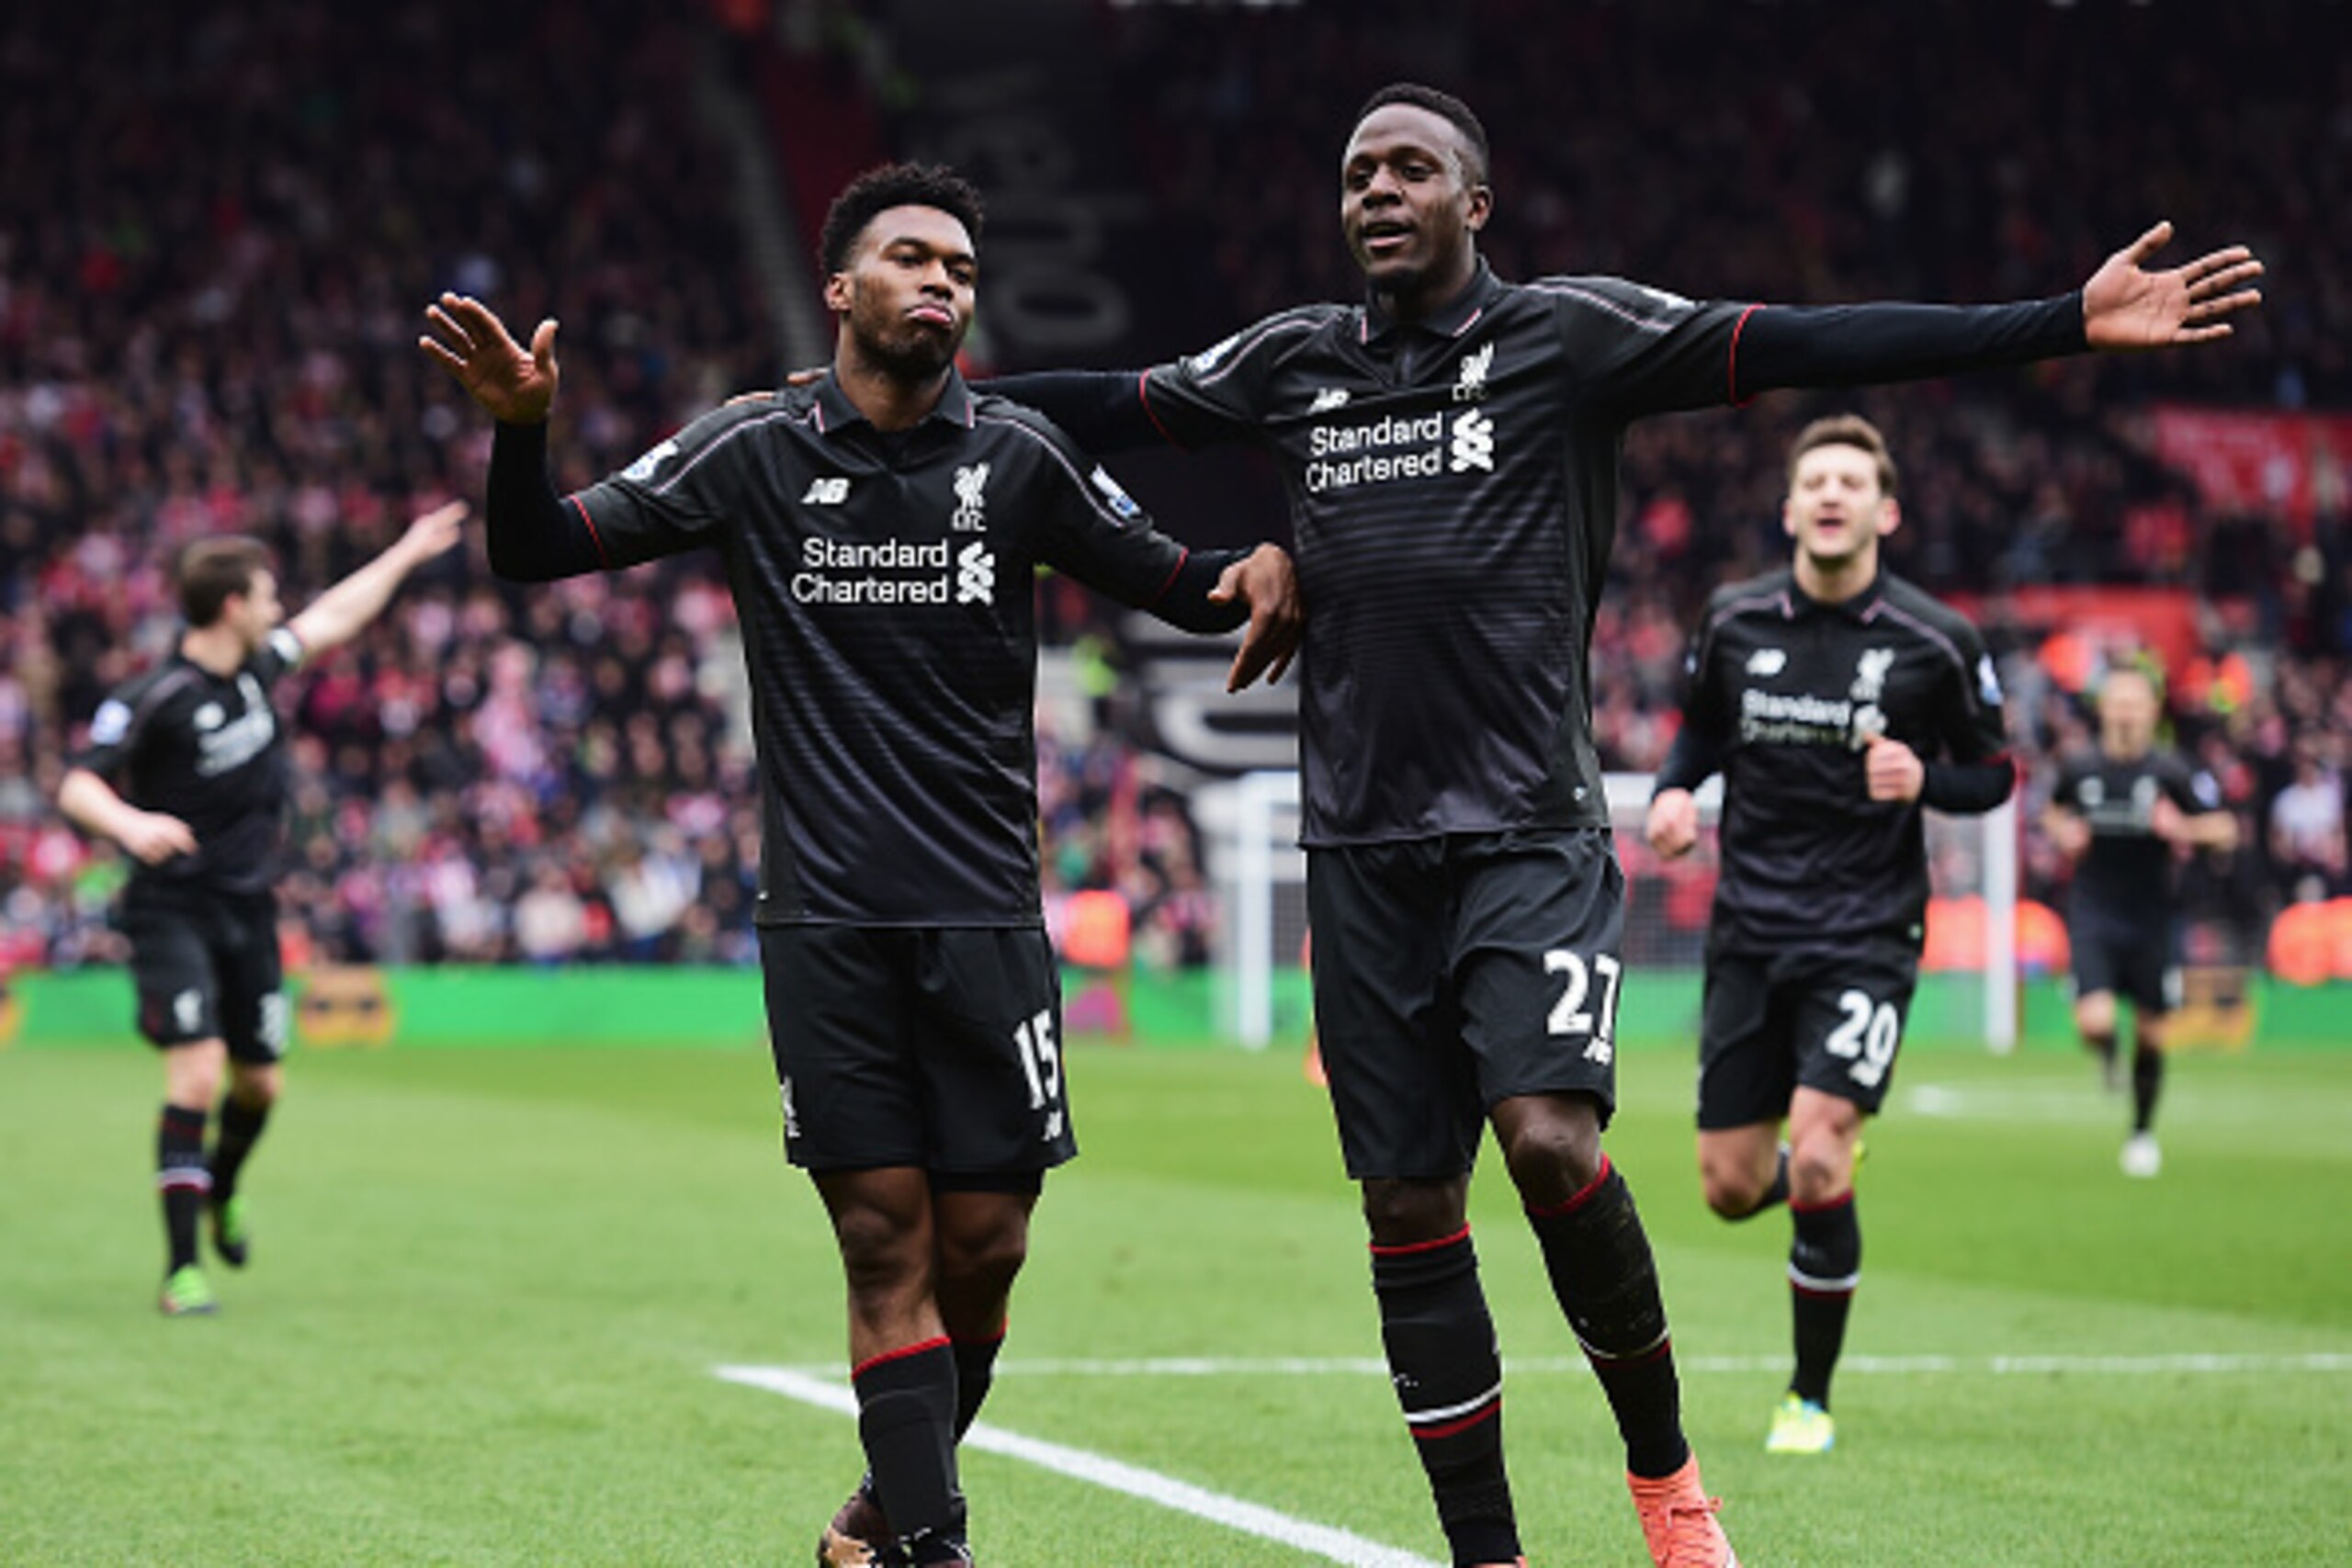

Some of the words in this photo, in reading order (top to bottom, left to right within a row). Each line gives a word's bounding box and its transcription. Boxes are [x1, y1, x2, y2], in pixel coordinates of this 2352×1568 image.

[1309, 412, 1443, 457] Standard
[1306, 446, 1442, 493] Chartered
[802, 536, 948, 568] Standard
[791, 572, 948, 603] Chartered
[1544, 949, 1620, 1040] 27
[1825, 989, 1899, 1066] 20
[1013, 1009, 1058, 1110] 15
